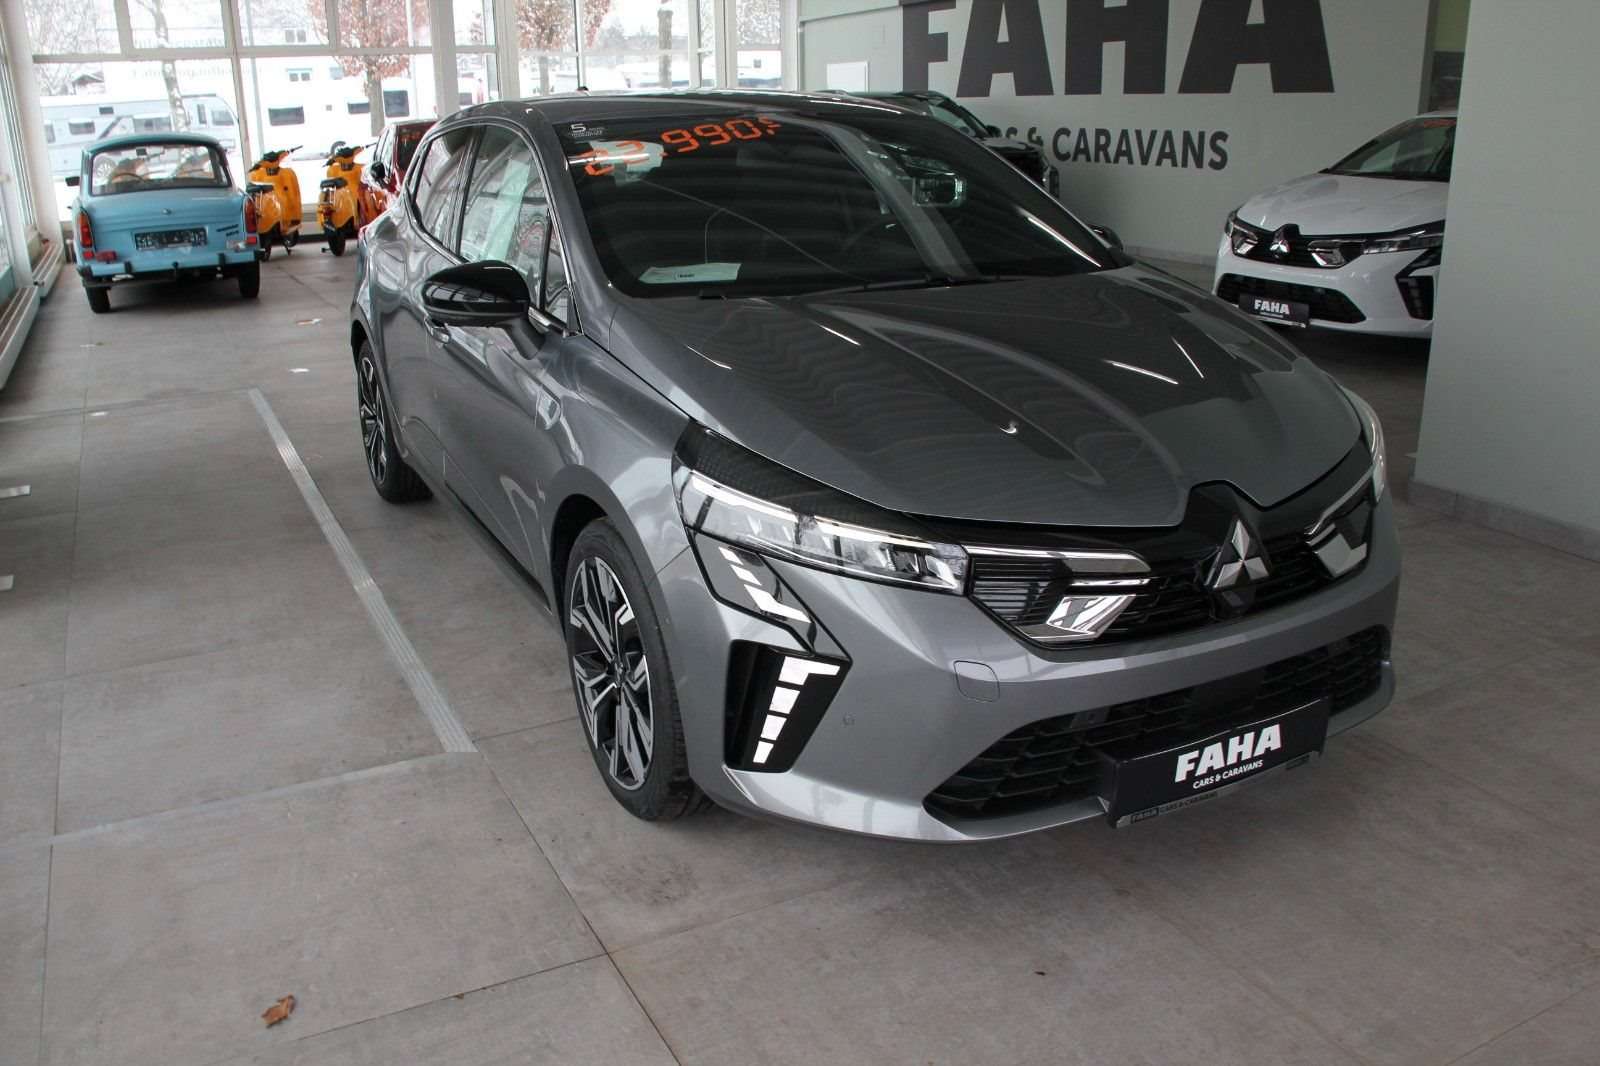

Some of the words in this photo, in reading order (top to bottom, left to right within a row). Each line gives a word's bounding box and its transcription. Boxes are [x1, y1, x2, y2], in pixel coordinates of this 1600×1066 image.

[902, 0, 1335, 97] FAHA
[1053, 127, 1229, 170] CARAVANS
[1254, 299, 1290, 315] FAHA
[1174, 724, 1282, 783] FAHA
[1192, 775, 1215, 789] CARS
[1222, 759, 1264, 779] CARAVANS
